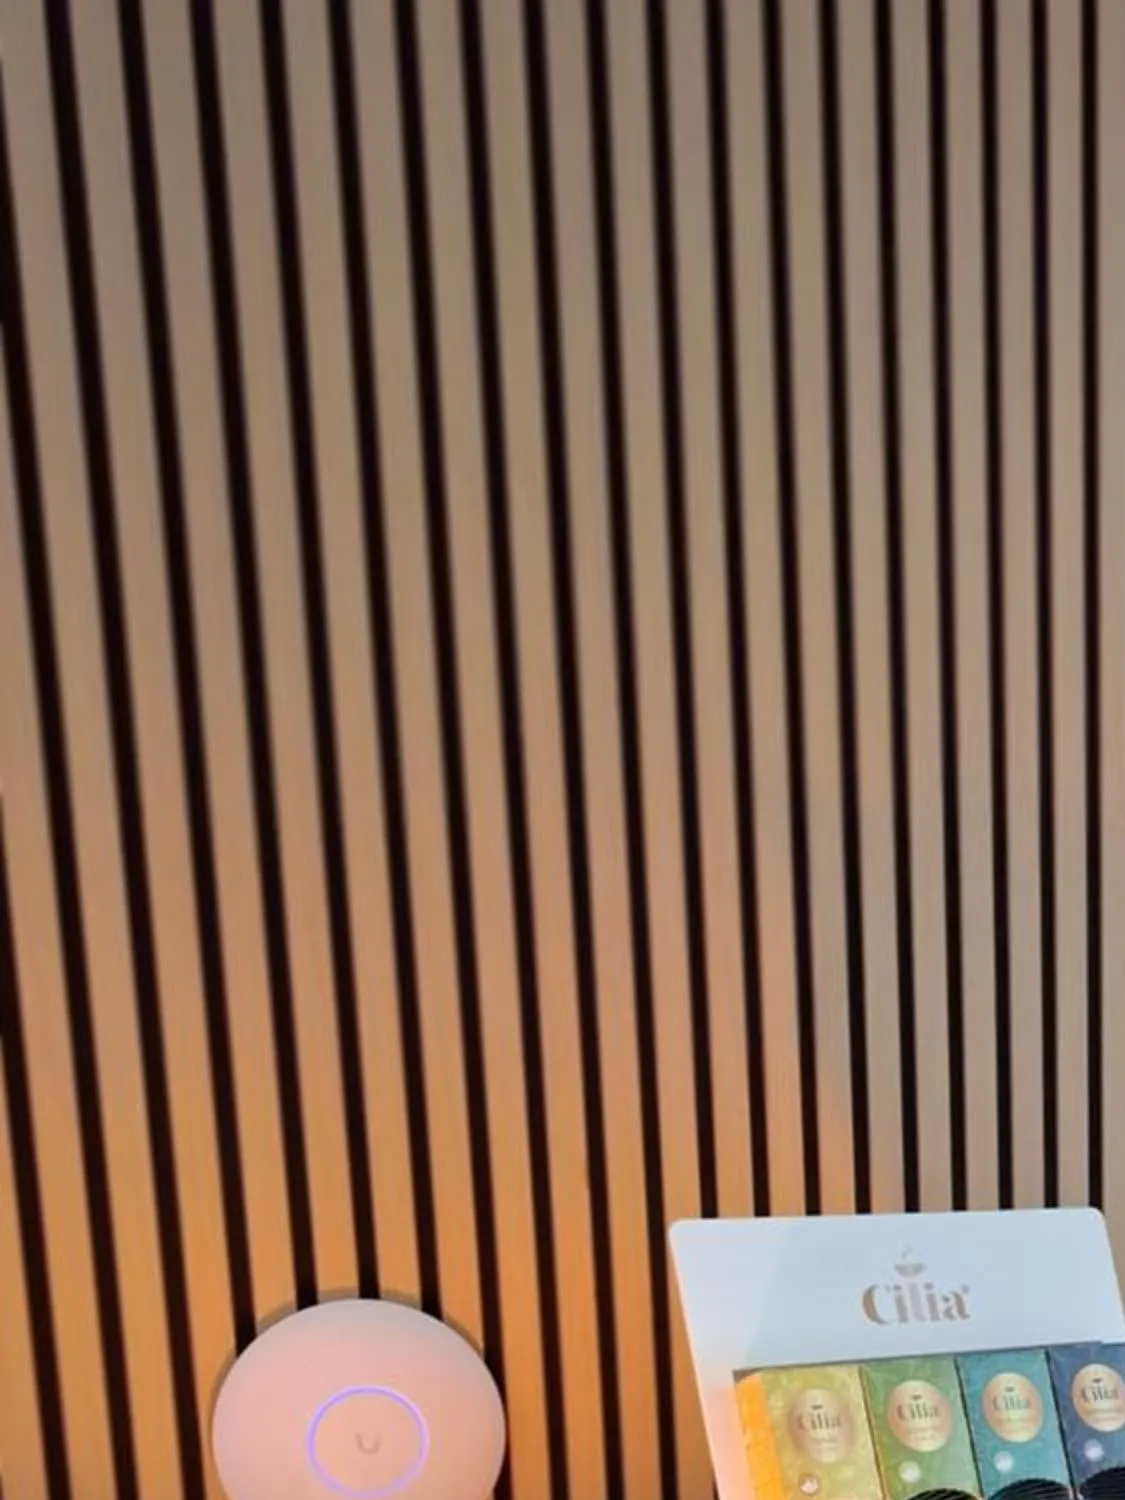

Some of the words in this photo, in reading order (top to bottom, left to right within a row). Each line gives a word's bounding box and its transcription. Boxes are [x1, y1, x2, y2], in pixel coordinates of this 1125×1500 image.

[861, 1283, 971, 1325] Cilia
[991, 1392, 1031, 1412] Cilia
[1079, 1384, 1119, 1404] Cilia
[897, 1400, 939, 1422] Cilia
